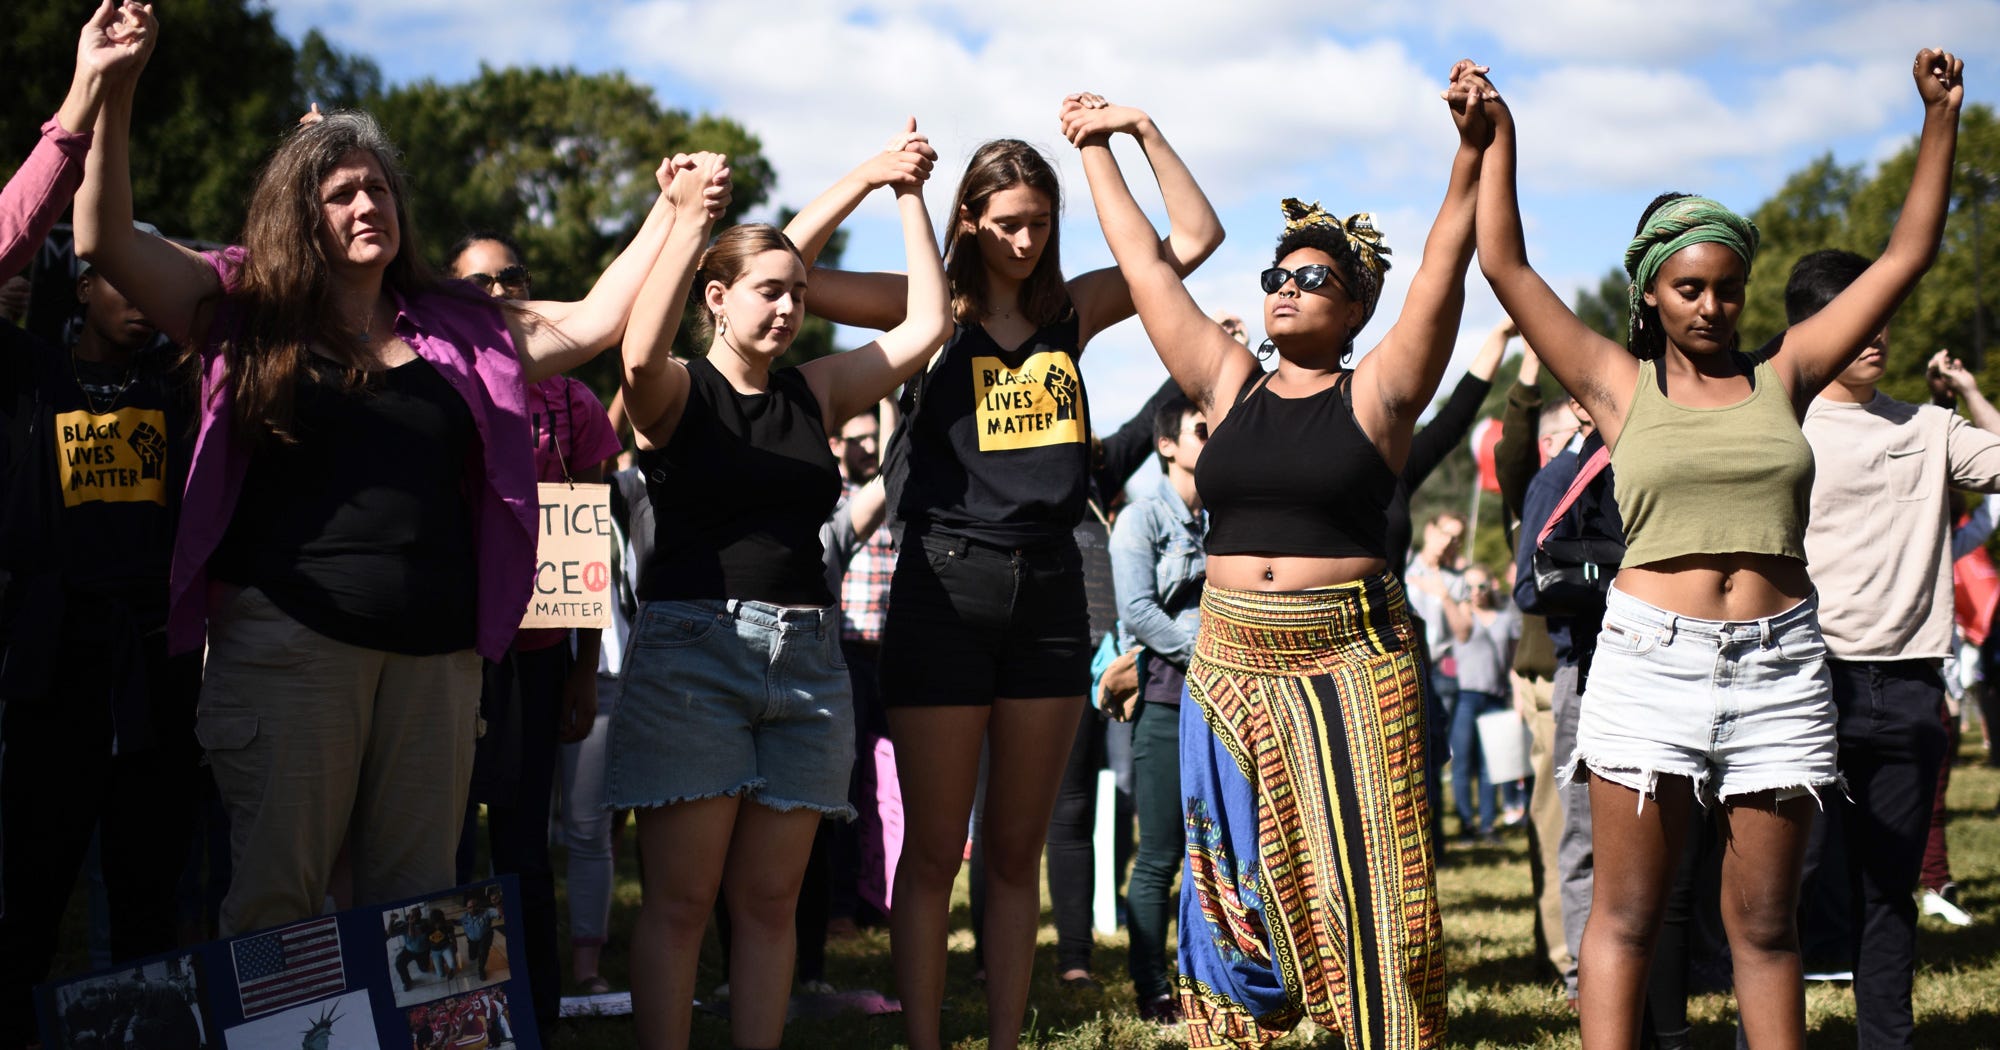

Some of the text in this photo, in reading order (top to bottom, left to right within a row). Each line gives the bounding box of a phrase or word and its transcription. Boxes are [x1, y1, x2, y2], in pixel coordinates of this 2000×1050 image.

[985, 391, 1033, 412] LIVES
[63, 421, 122, 443] BLACK
[987, 412, 1053, 435] MATTER
[66, 445, 115, 467] LIVES
[71, 468, 141, 491] MATTER
[540, 504, 610, 535] TICE
[535, 561, 582, 594] CE
[536, 603, 602, 616] MATTER
